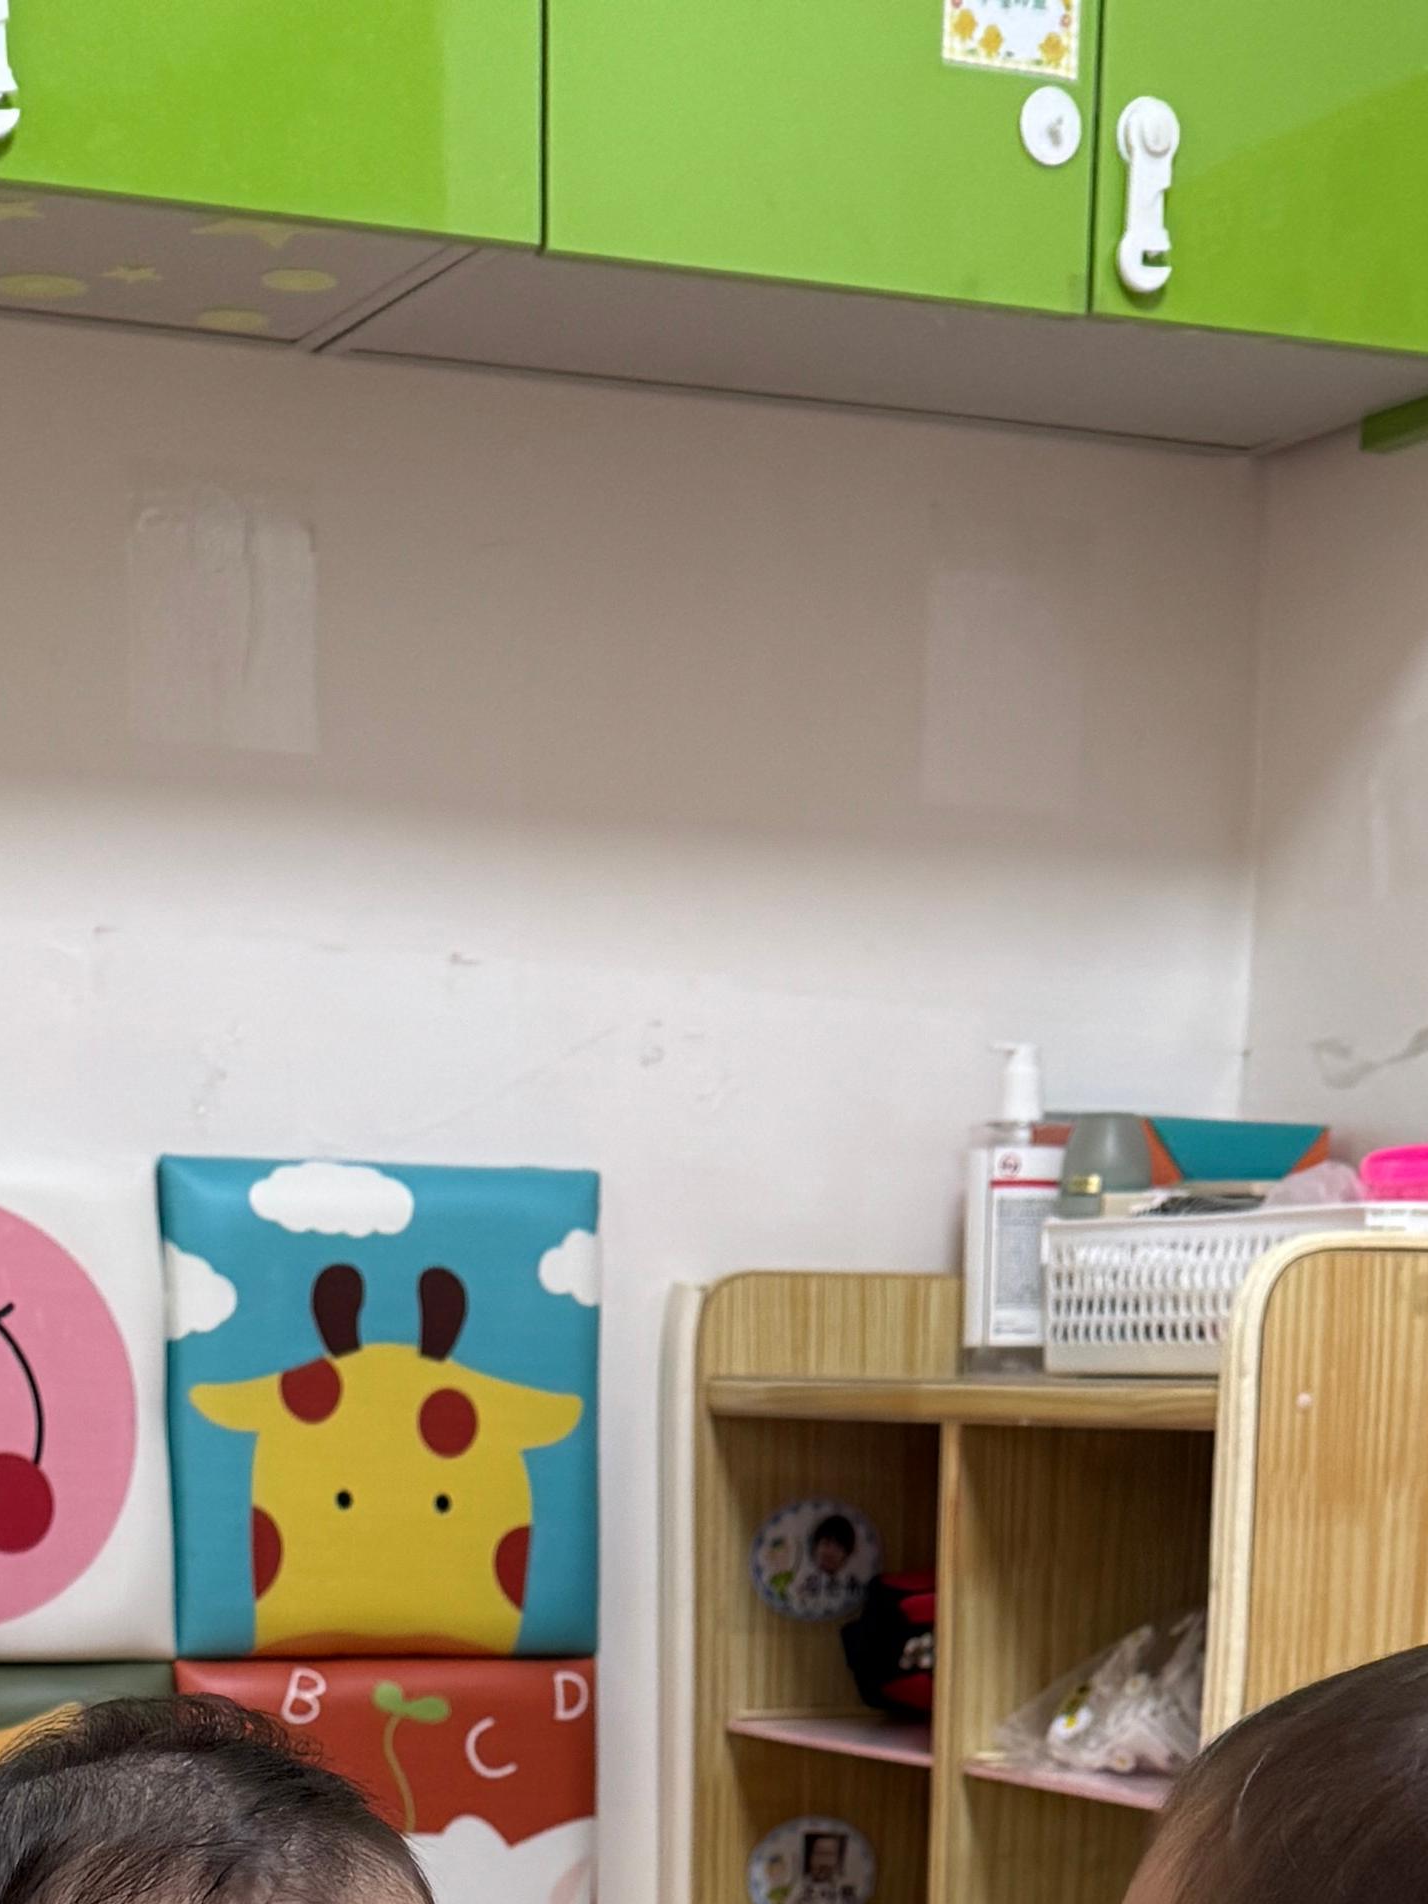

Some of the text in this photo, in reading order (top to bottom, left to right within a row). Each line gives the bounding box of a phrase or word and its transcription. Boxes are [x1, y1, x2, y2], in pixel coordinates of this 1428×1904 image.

[280, 1667, 328, 1727] B
[553, 1670, 590, 1721] D
[464, 1716, 518, 1779] C
